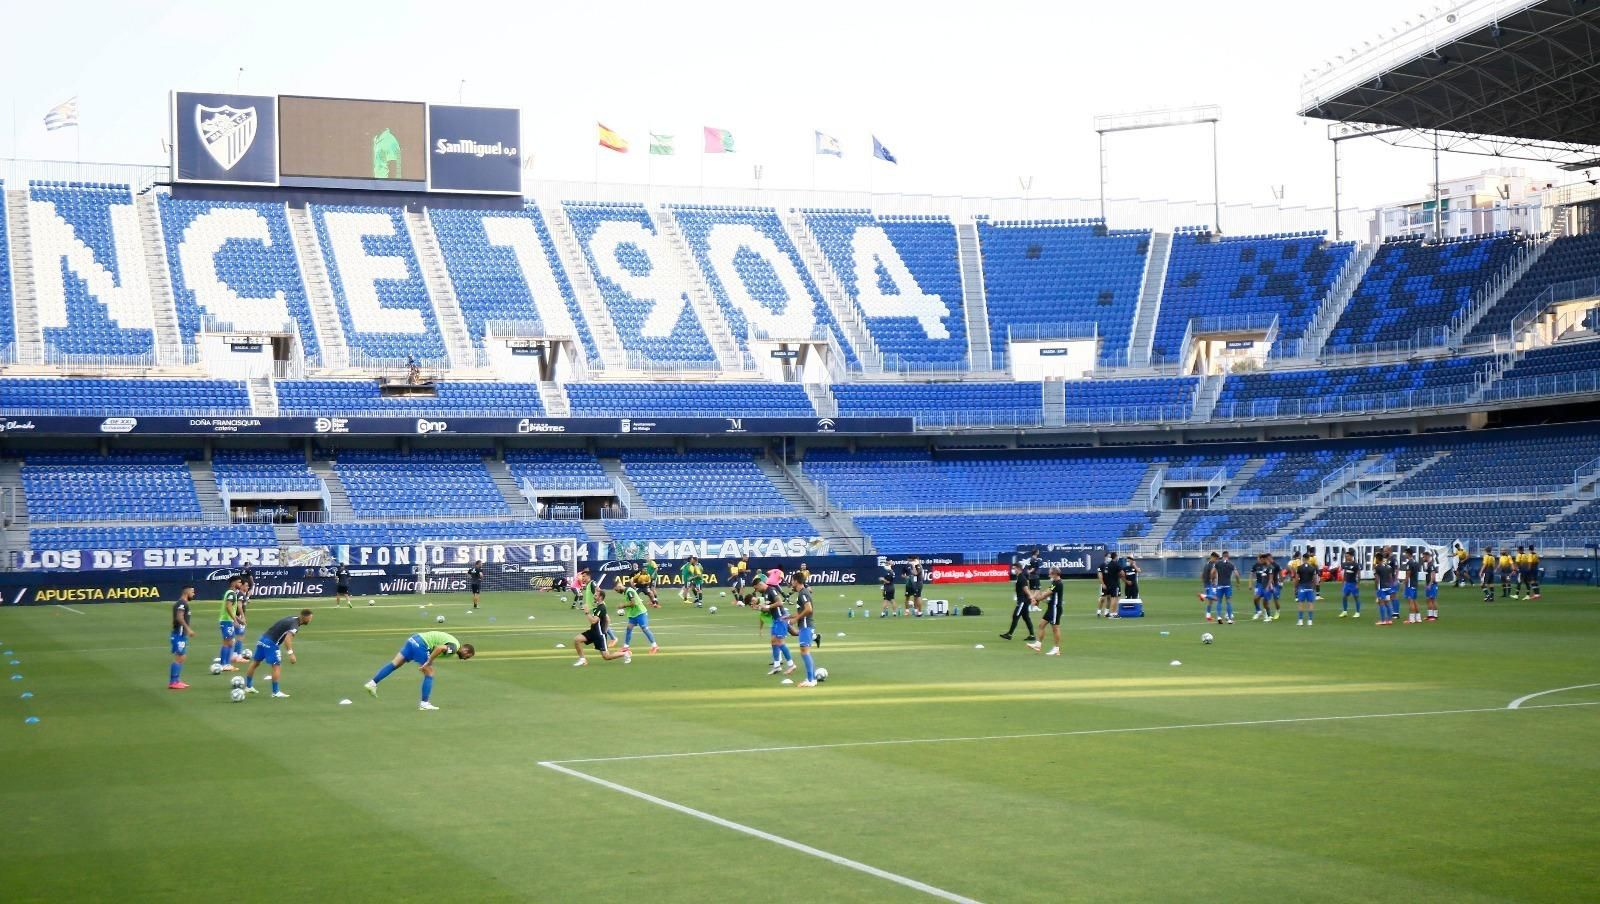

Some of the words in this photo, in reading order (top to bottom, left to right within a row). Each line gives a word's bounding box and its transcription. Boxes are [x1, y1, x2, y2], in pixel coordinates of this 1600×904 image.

[481, 215, 950, 340] 1904
[22, 550, 81, 568] LOS
[93, 549, 133, 568] DE
[144, 547, 280, 567] SIEMPRE
[360, 546, 445, 565] FONDO
[457, 545, 506, 563] SUR
[529, 543, 589, 562] 1904
[645, 537, 808, 559] MALAKAS
[35, 587, 104, 601] APUESTA
[106, 586, 160, 599] AHORA
